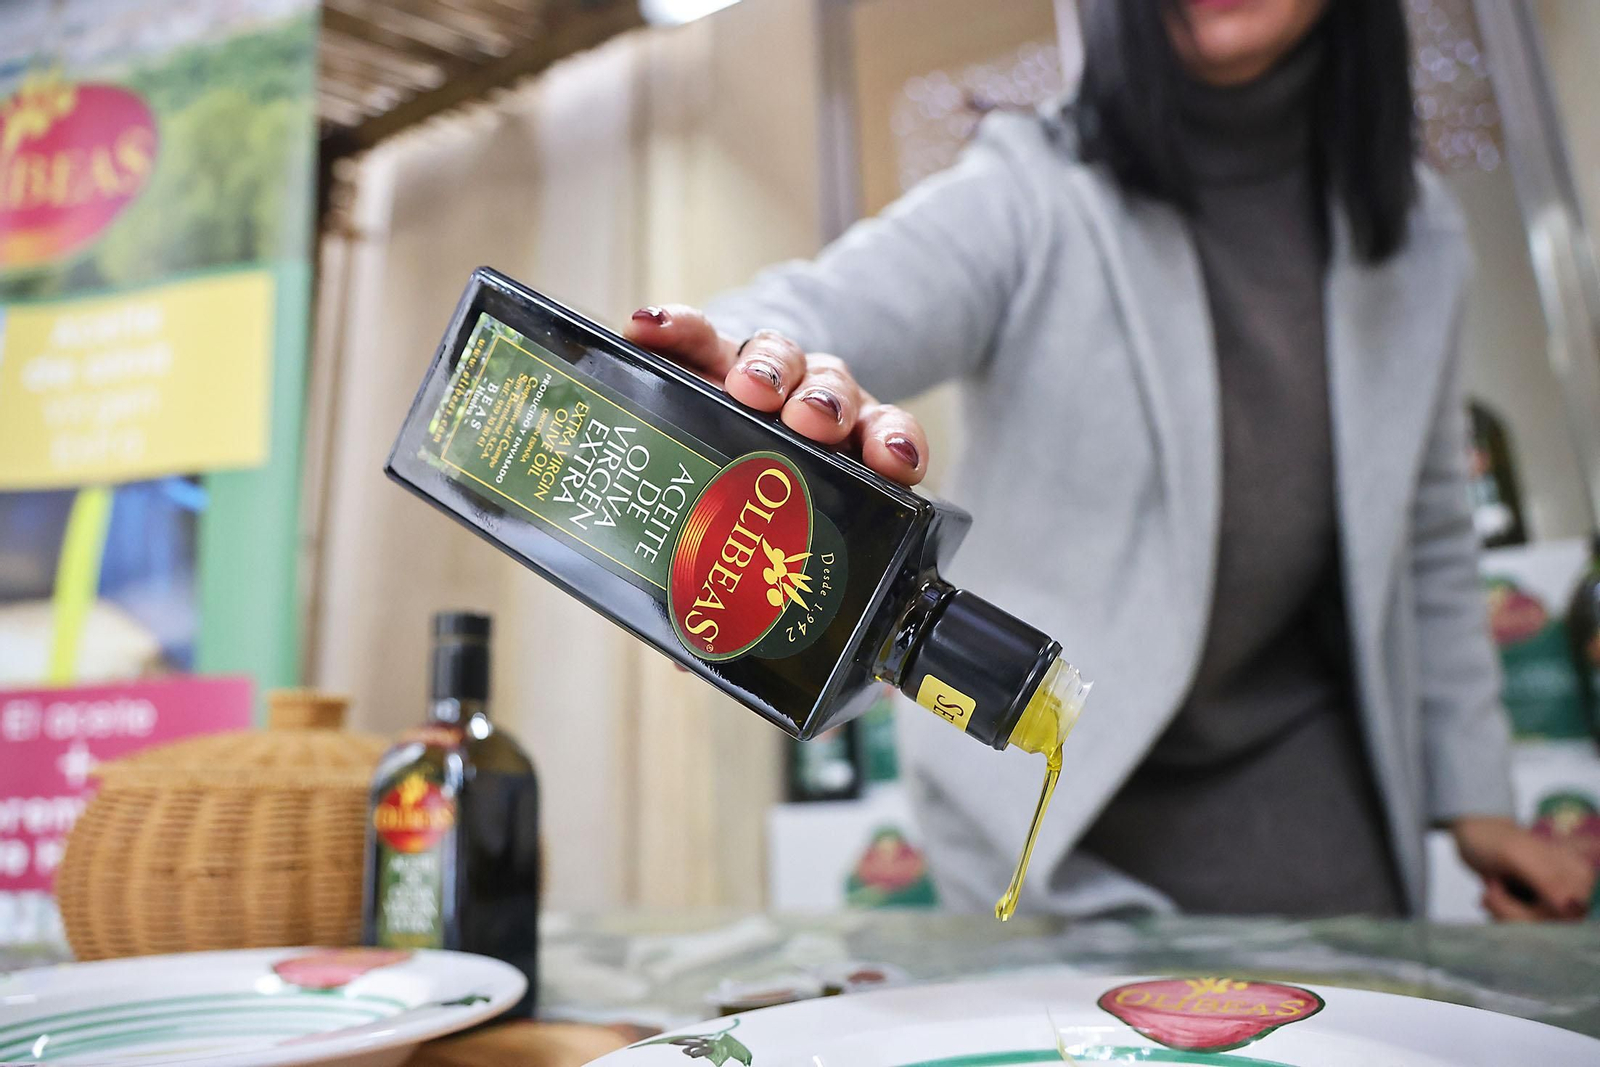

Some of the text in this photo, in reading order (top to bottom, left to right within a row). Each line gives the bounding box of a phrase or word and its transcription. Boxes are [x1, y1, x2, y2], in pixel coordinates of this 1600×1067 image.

[467, 385, 487, 416] Huelva
[470, 382, 499, 430] BEAS
[494, 372, 552, 485] PRODUCIDO Y ENVASADO
[531, 406, 550, 436] ORIGEN
[526, 408, 567, 477] OLIVE OIL
[532, 400, 589, 501] EXTRA VIRGIN
[551, 417, 610, 502] EXTRA
[568, 426, 636, 531] VIRGEN
[593, 445, 648, 526] OLIVA
[625, 478, 662, 524] DE
[633, 461, 694, 564] ACEITE
[820, 552, 835, 597] Desde
[933, 694, 964, 724] SE
[1114, 988, 1306, 1017] OLIBEAS
